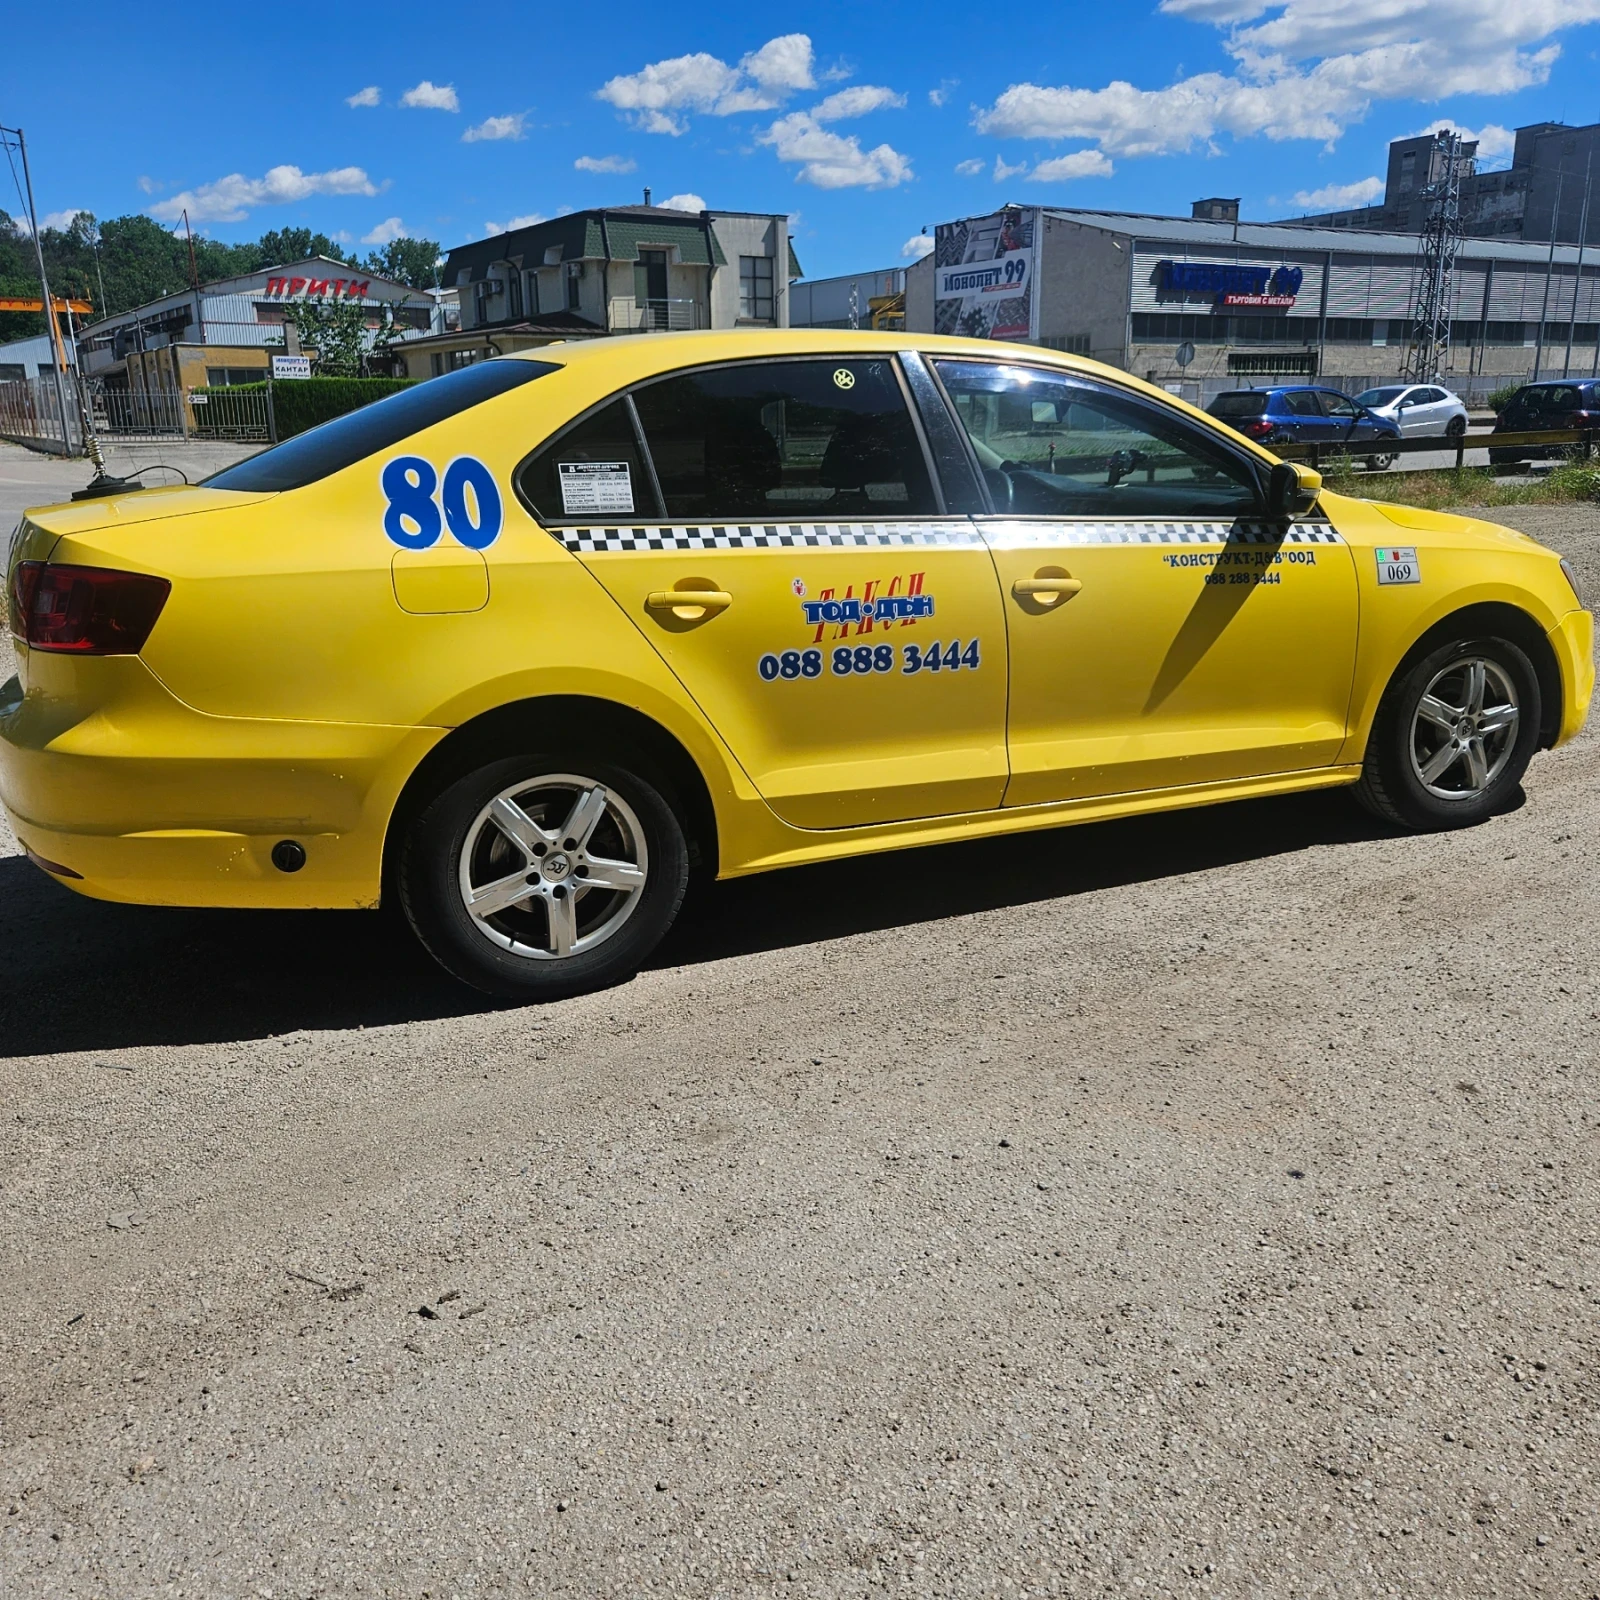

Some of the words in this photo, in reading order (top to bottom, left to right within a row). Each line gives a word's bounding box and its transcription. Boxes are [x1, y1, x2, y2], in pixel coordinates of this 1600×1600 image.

[1004, 258, 1026, 283] 99
[266, 276, 370, 297] ПРИТИ
[380, 455, 503, 551] 80
[1205, 574, 1226, 584] 088
[1229, 573, 1250, 584] 288
[1253, 572, 1280, 584] 3444
[1388, 564, 1411, 581] 069
[758, 647, 823, 682] 088
[831, 643, 894, 677] 888
[901, 638, 980, 675] 3444
